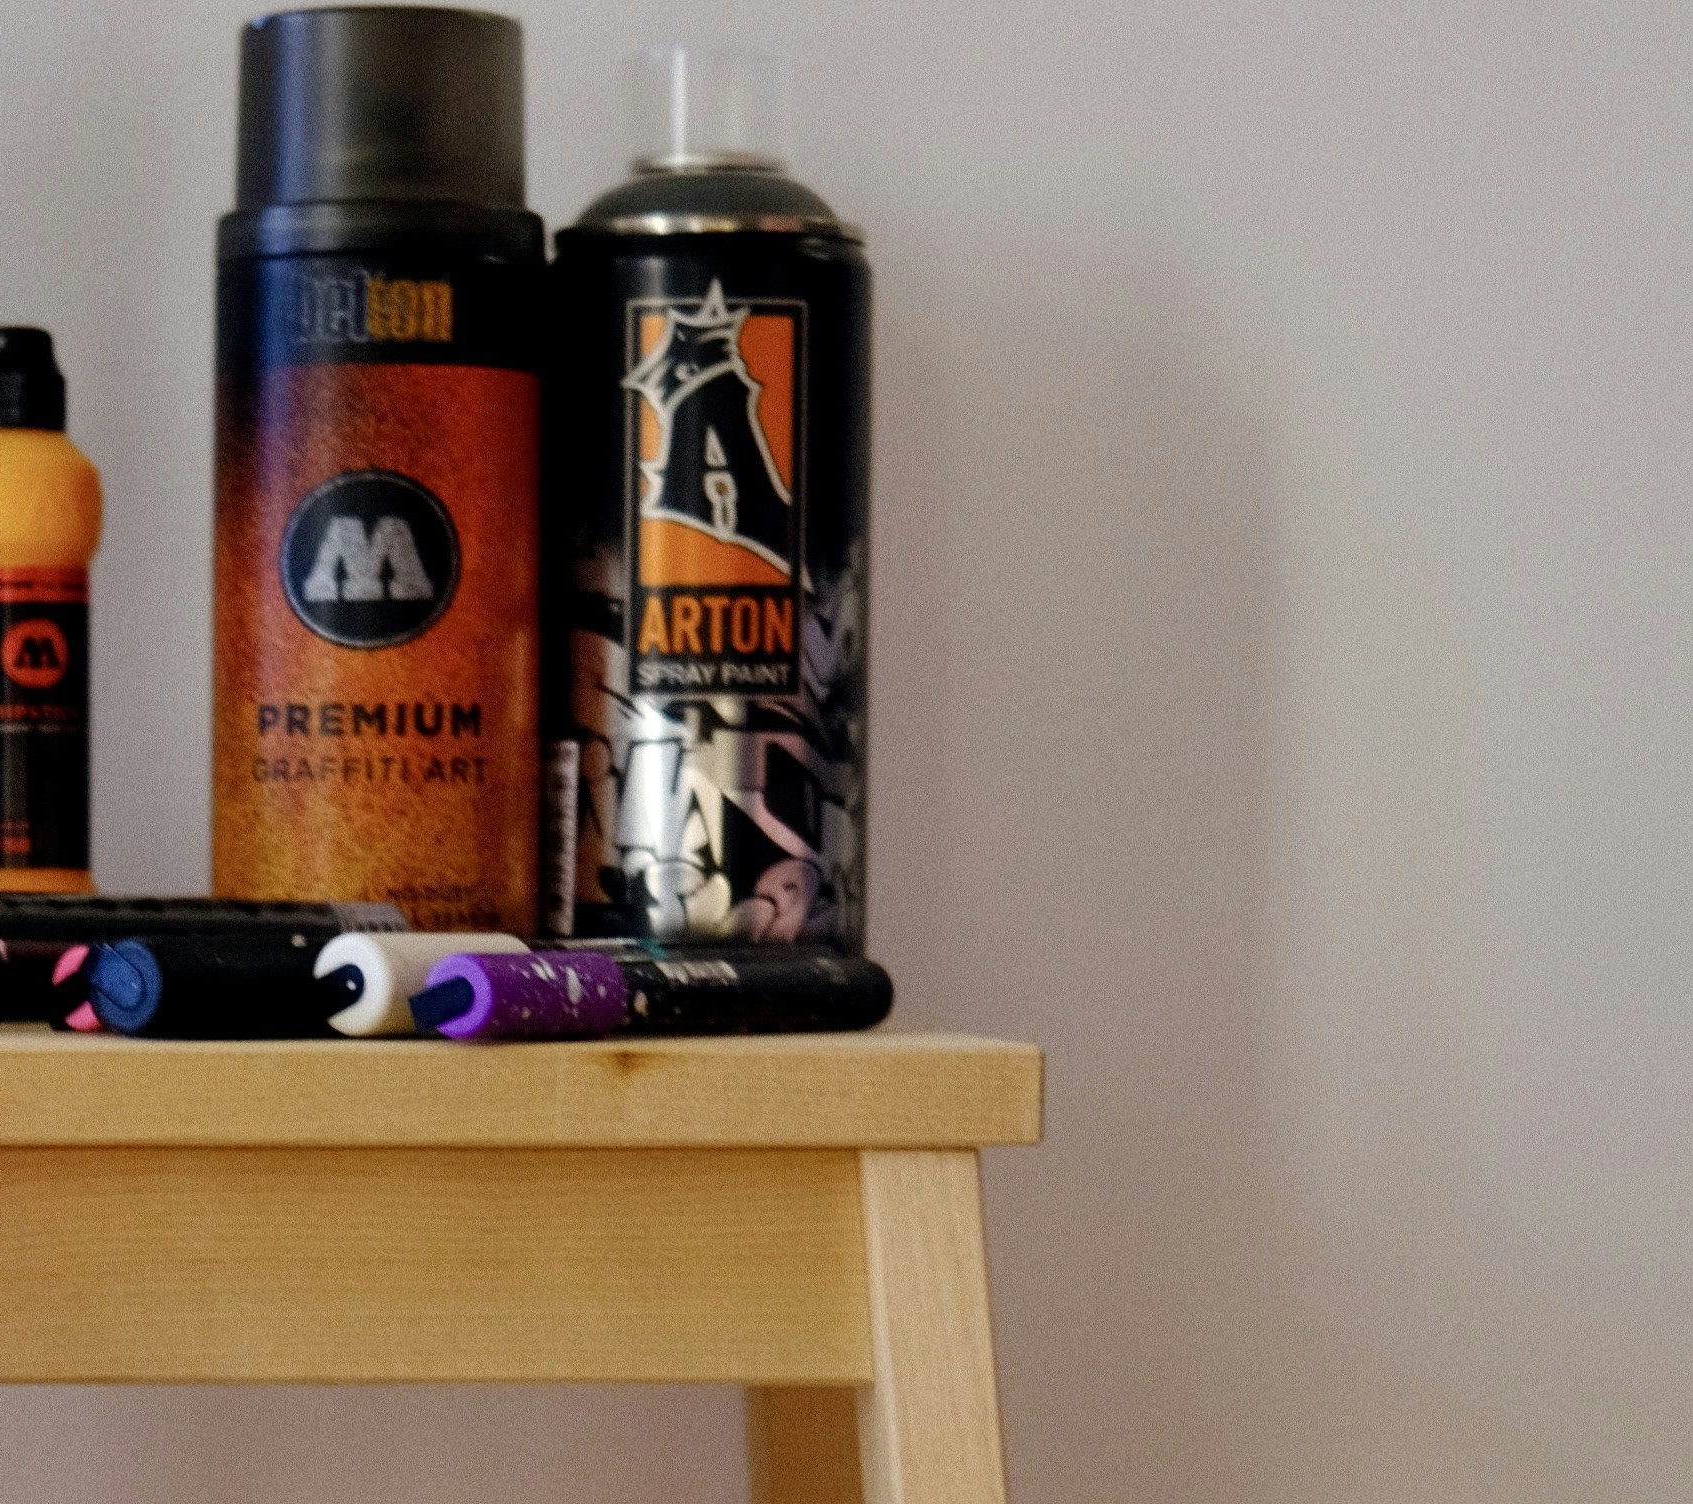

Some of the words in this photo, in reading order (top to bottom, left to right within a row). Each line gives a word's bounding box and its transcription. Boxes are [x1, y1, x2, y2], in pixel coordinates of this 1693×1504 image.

[637, 596, 794, 656] ARTON
[637, 662, 717, 687] SPRAY
[721, 662, 791, 687] PAINT
[257, 703, 483, 739] PREMIUM
[251, 755, 408, 785] GRAFFITI
[423, 755, 489, 784] ART
